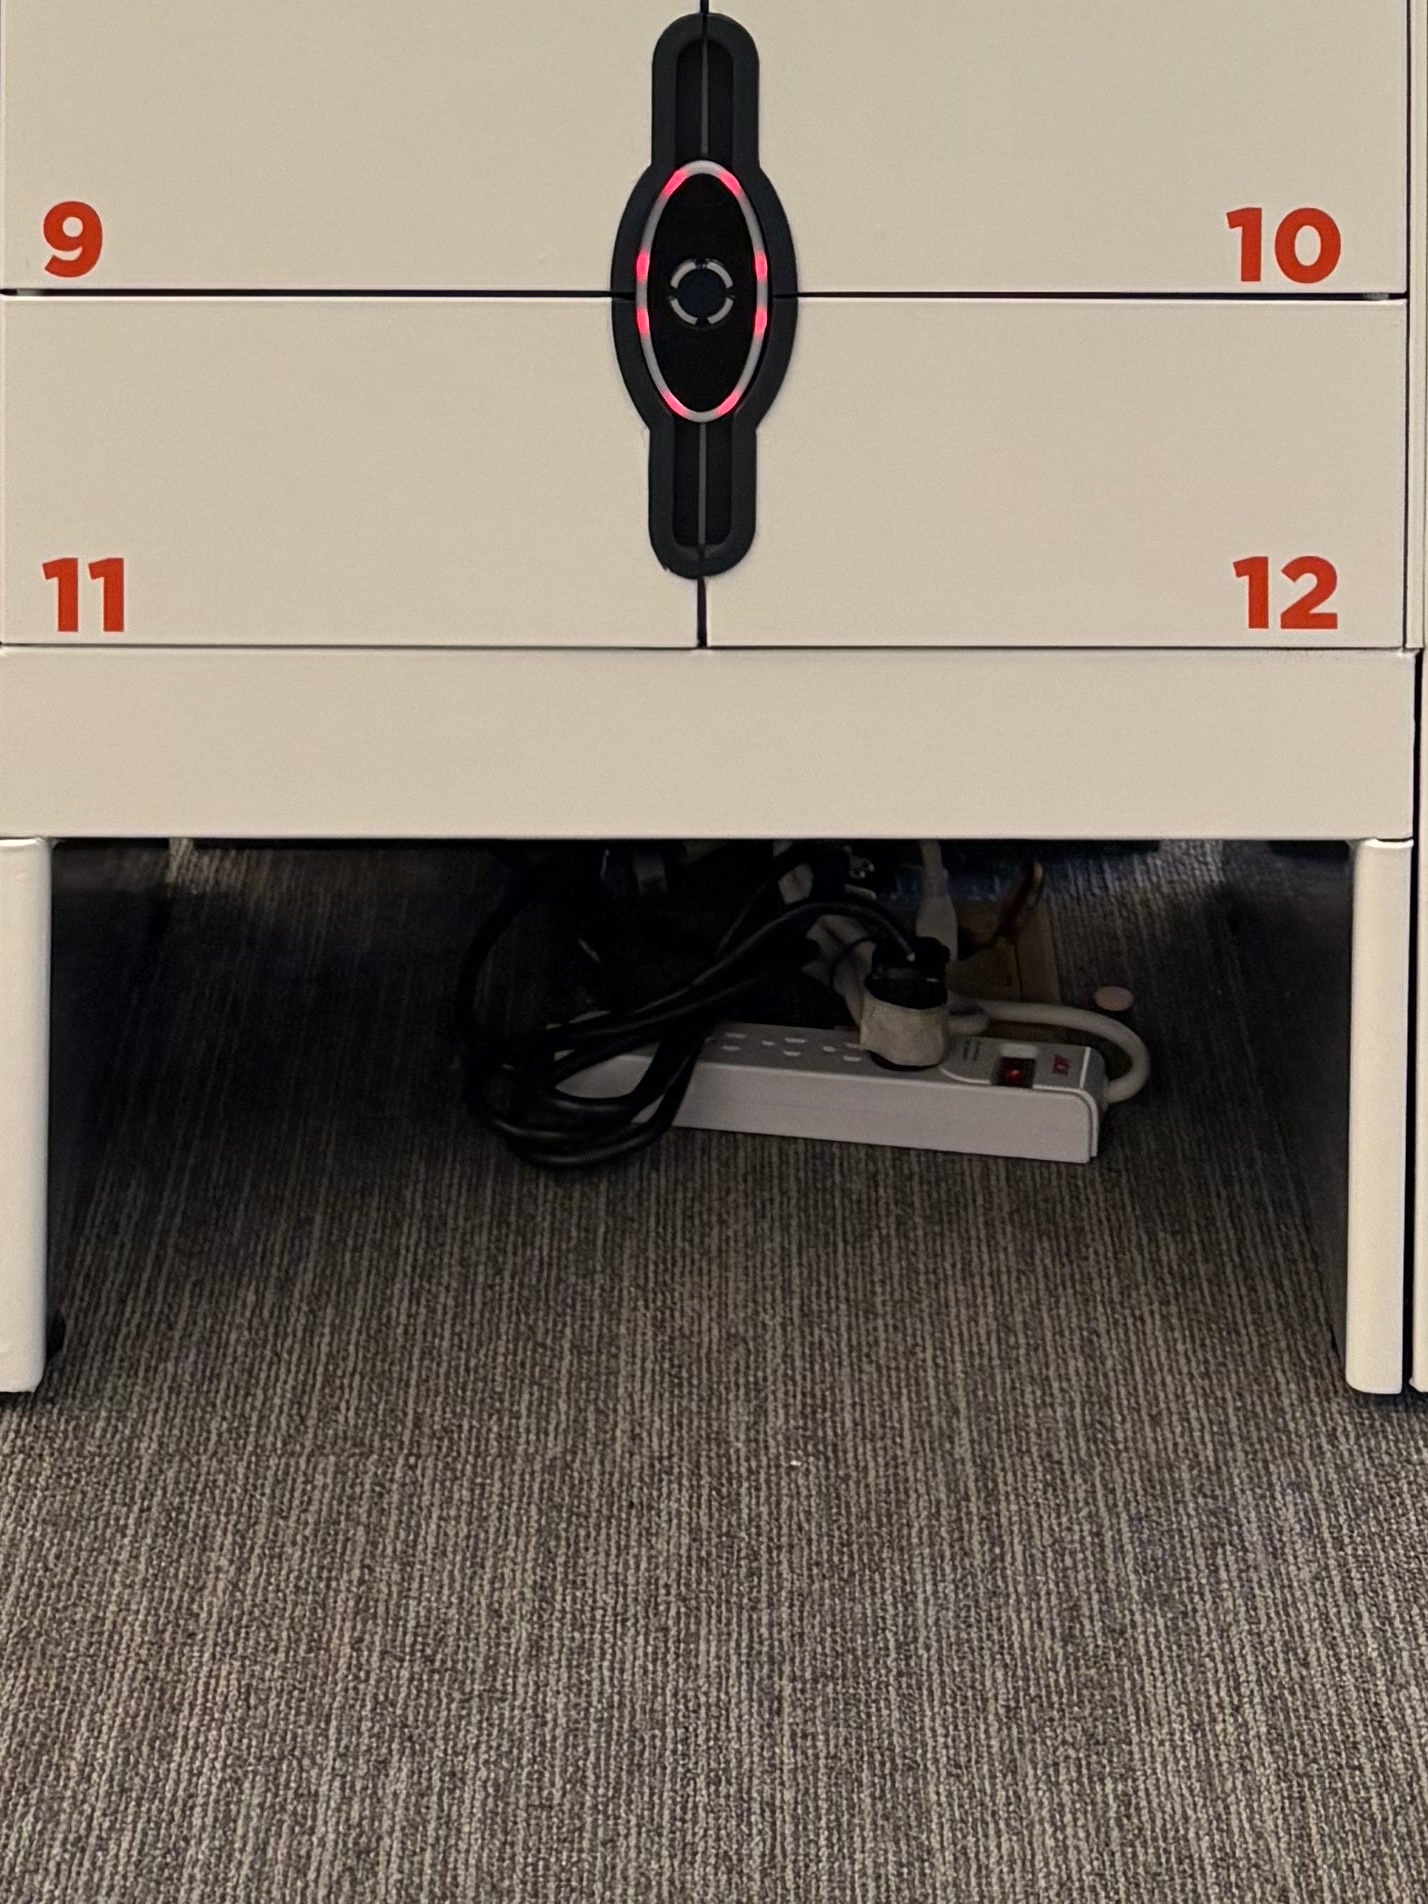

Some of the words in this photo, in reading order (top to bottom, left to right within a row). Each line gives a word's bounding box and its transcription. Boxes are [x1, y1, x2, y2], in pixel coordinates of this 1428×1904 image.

[42, 201, 102, 279] 9
[1227, 208, 1341, 284] 10
[42, 558, 124, 633] 11
[1233, 556, 1338, 630] 12
